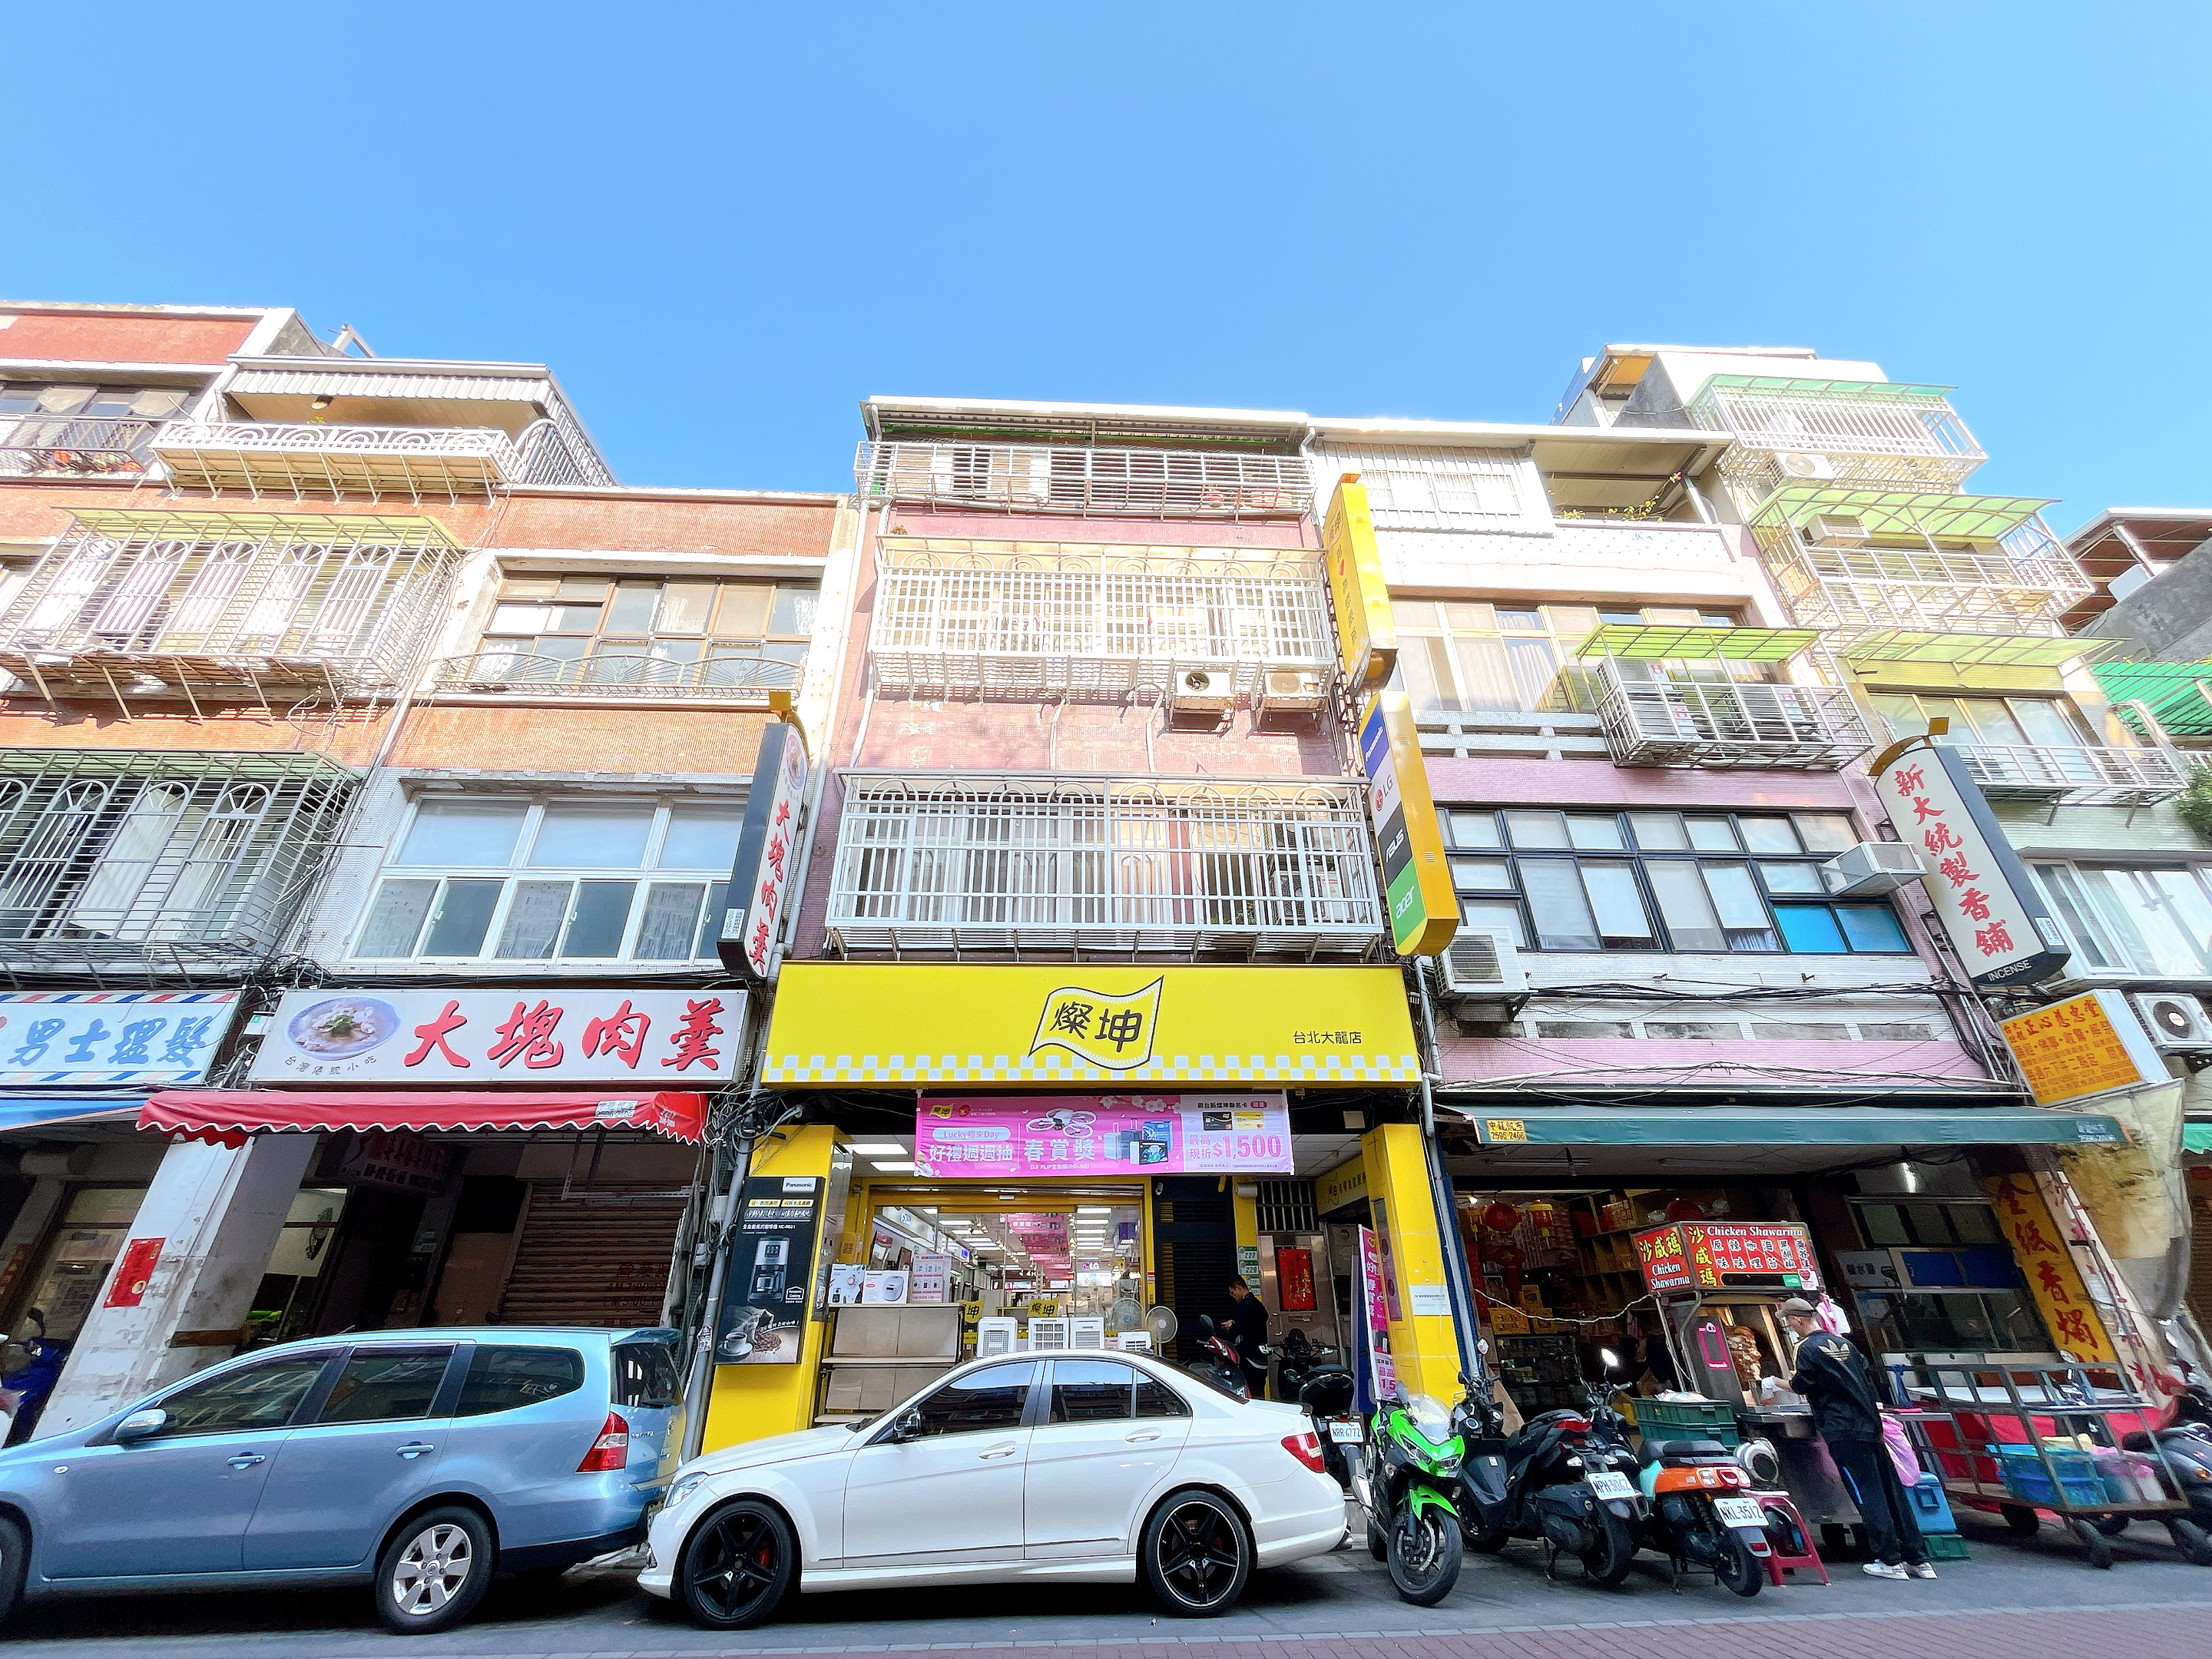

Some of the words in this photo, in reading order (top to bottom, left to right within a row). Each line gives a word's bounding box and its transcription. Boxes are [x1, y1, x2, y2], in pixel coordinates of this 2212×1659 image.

[1364, 725, 1384, 763] Panasonic
[1383, 773, 1393, 798] LG
[1386, 828, 1405, 864] ASUS
[750, 799, 791, 975] 大塊肉羹
[1396, 885, 1415, 920] acer
[1988, 959, 2032, 982] INCENSE
[403, 998, 725, 1072] 大塊肉羹
[1052, 1002, 1143, 1054] 燦坤
[1293, 1030, 1363, 1045] 台北大龍店
[8, 1015, 214, 1068] 男士理髮
[943, 1130, 999, 1140] Lucky福來Day
[1189, 1134, 1210, 1146] 最高
[1213, 1134, 1281, 1159] $1,500
[929, 1144, 1013, 1162] 好禮週週抽
[1024, 1139, 1095, 1162] 春賞獎
[1189, 1147, 1211, 1159] 現折
[1707, 1226, 1747, 1237] Chicken
[1750, 1227, 1803, 1237] Shawarma
[1639, 1231, 1683, 1262] 沙威瑪
[1688, 1226, 1717, 1286] 沙威瑪
[1713, 1240, 1729, 1268] 原味
[1651, 1262, 1681, 1277] Chicken
[1997, 1177, 2101, 1363] 金紙香燭
[1651, 1275, 1690, 1291] Shawarma
[964, 1304, 980, 1319] 坤
[1332, 1427, 1361, 1438] NRR-6772
[1593, 1479, 1631, 1494] NPH-3062
[1720, 1505, 1763, 1520] NKL-3512
